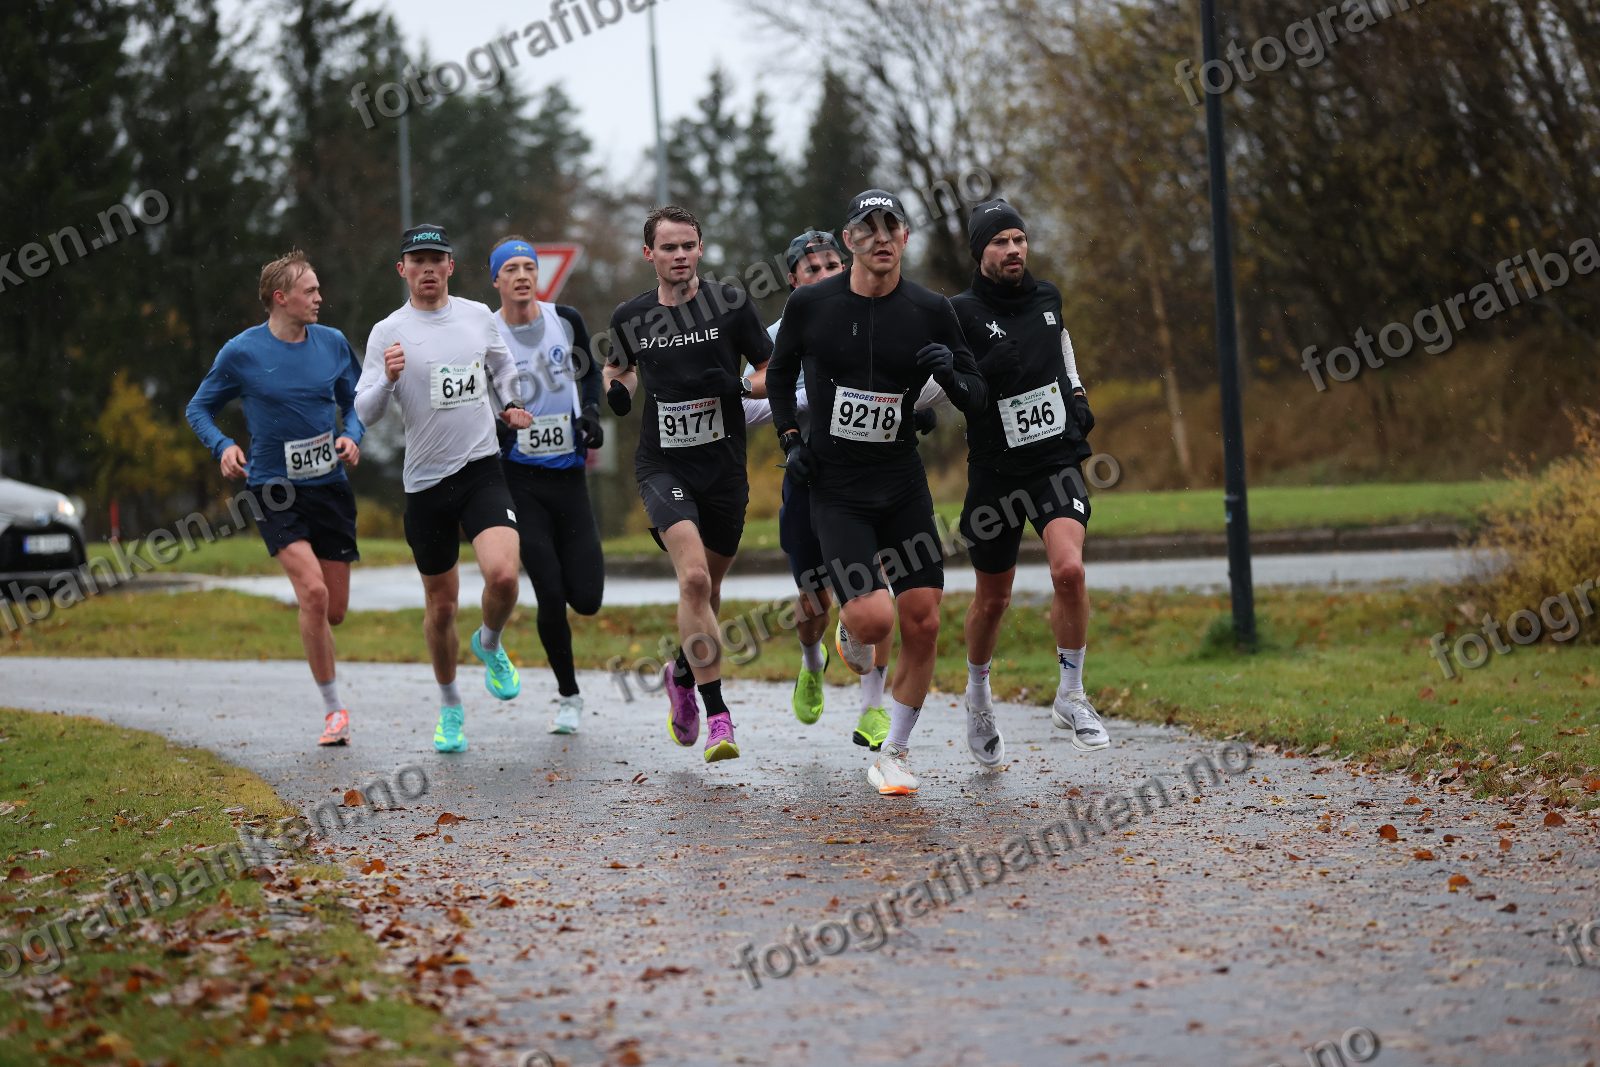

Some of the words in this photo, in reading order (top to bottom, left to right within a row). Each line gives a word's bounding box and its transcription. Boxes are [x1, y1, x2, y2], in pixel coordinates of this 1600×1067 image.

[860, 197, 893, 209] HOKA
[412, 231, 442, 243] HOKA
[442, 374, 476, 399] 614
[663, 408, 717, 437] 9177
[838, 401, 896, 431] 9218
[1016, 401, 1055, 434] 546
[529, 426, 564, 449] 548
[291, 442, 332, 470] 9478
